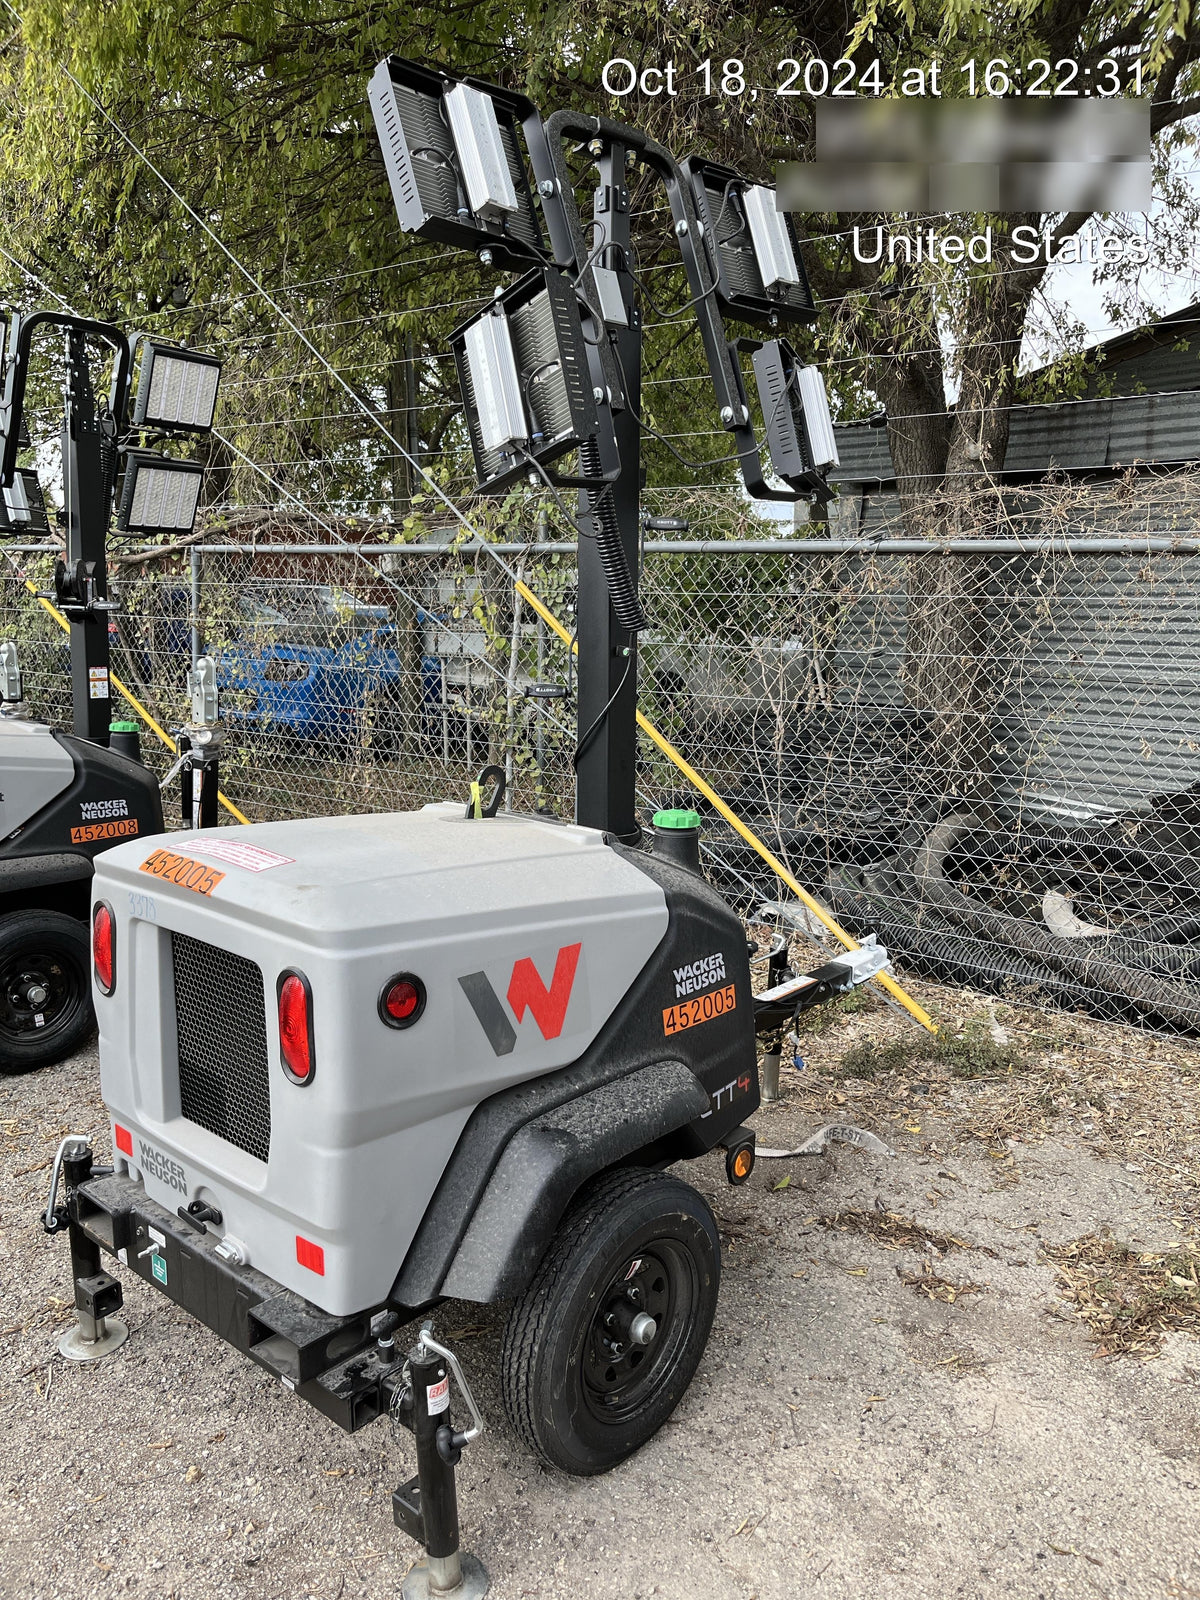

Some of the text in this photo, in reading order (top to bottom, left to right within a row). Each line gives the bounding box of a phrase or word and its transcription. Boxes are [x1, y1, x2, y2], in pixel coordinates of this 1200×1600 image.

[80, 799, 128, 812] WACKER
[81, 807, 129, 820] NEUSON
[73, 820, 137, 842] 452008
[144, 849, 222, 894] 452005
[672, 952, 725, 984] WACKER
[675, 965, 727, 999] NEUSON
[665, 985, 735, 1032] 452005
[138, 1139, 187, 1182] WACKER
[140, 1154, 188, 1197] NEUSON
